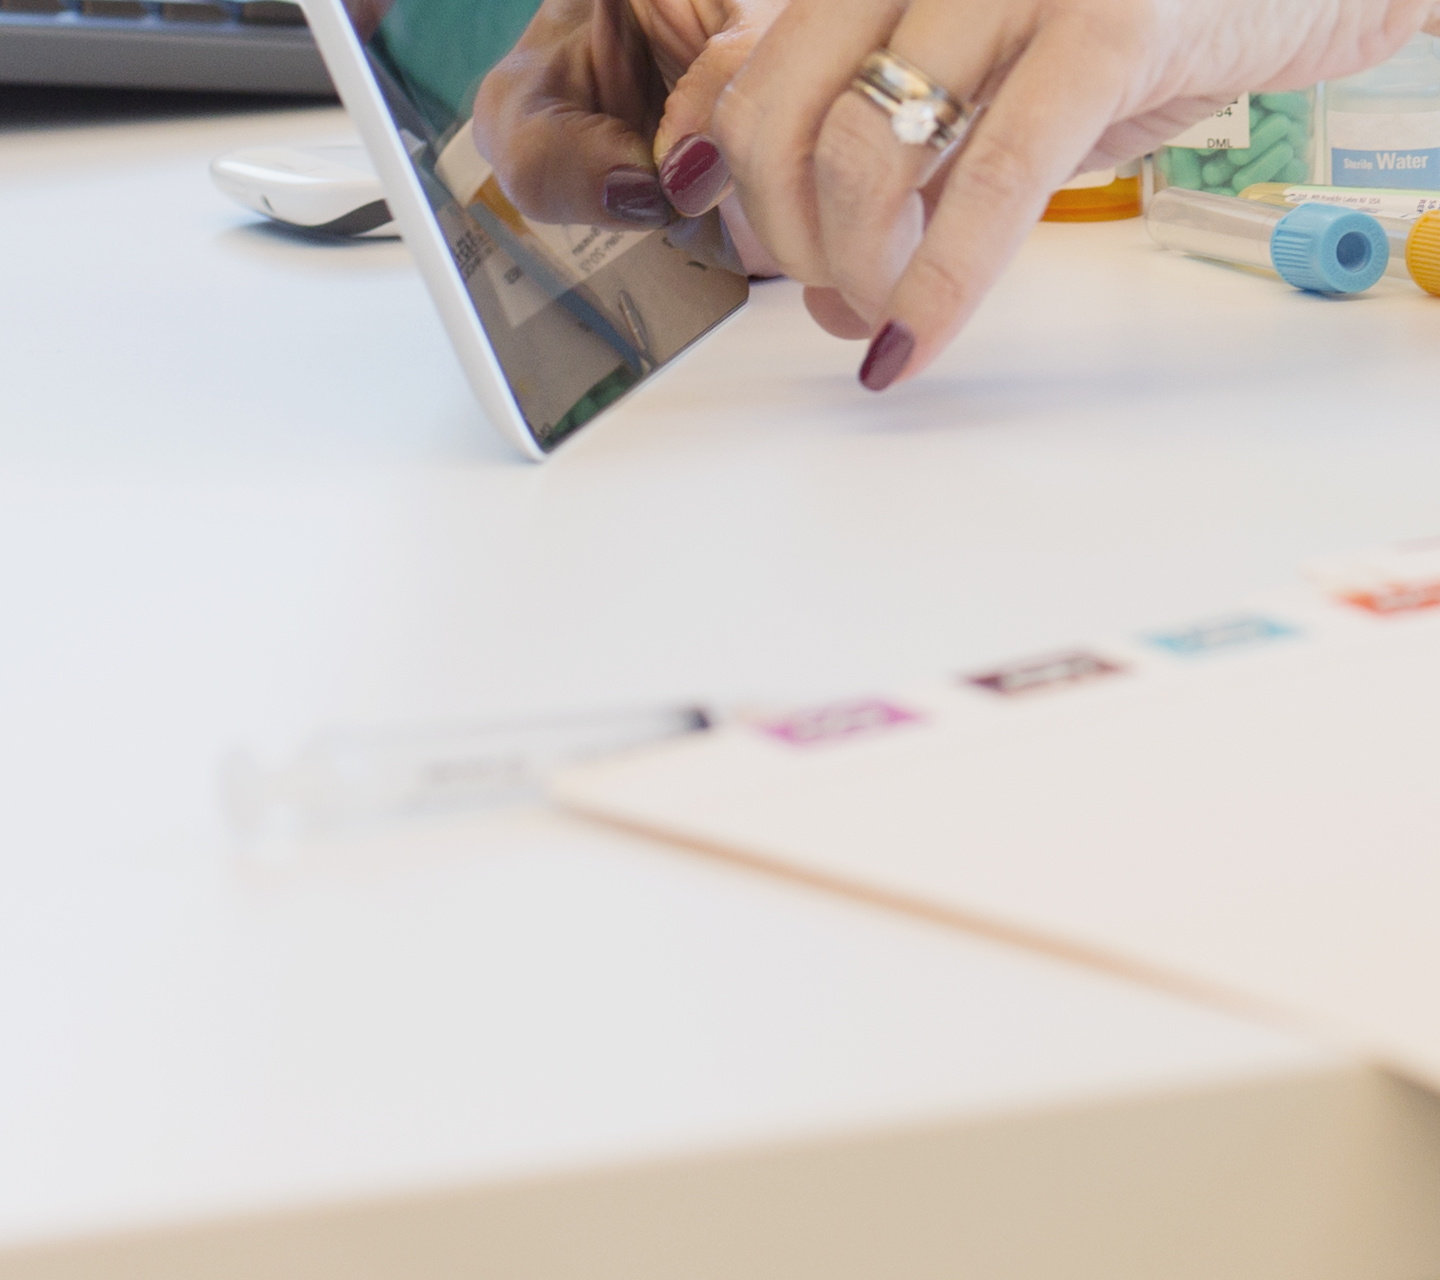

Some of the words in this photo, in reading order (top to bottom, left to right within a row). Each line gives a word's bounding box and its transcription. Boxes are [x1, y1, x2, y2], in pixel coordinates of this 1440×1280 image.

[1207, 138, 1233, 148] DML
[1343, 157, 1373, 170] Sterile
[1376, 152, 1429, 170] Water
